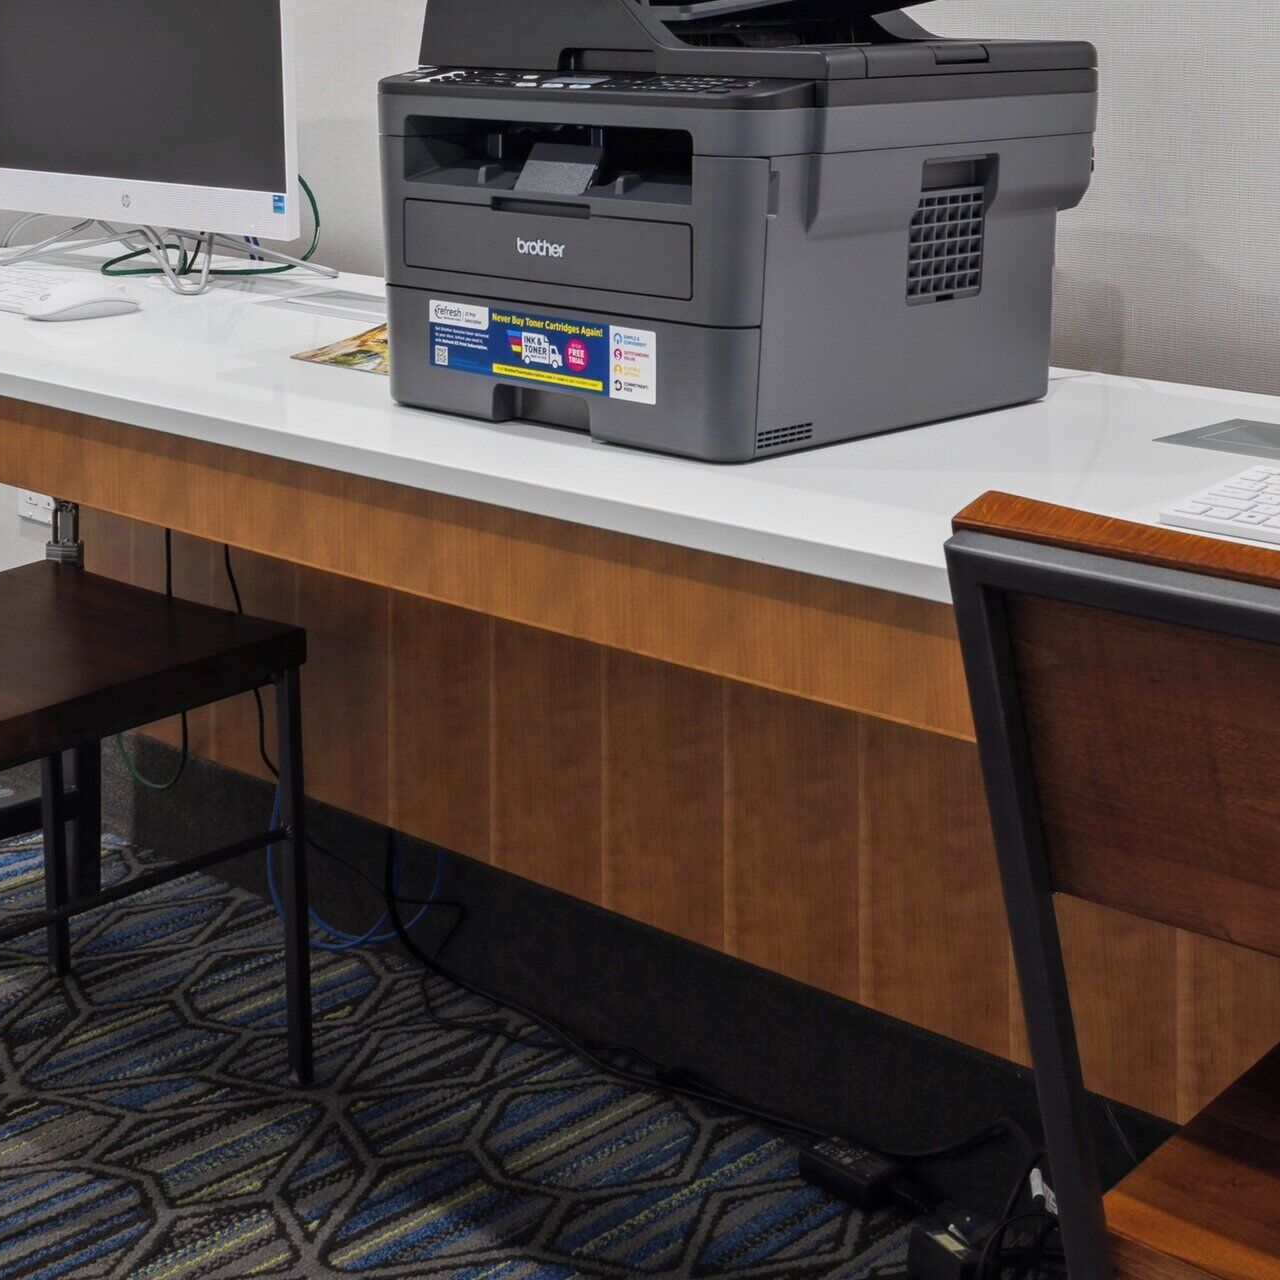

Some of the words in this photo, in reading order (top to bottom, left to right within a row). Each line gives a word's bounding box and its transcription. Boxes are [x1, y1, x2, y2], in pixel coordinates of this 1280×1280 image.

[516, 237, 565, 258] brother
[436, 305, 461, 318] refresh
[492, 313, 511, 322] Never
[511, 316, 524, 326] Buy
[525, 318, 544, 328] Toner
[545, 321, 580, 334] Cartridges
[581, 326, 603, 337] Again!
[524, 336, 536, 344] INK
[537, 338, 542, 346] &
[524, 344, 547, 356] TONER
[568, 348, 585, 358] FREE
[568, 355, 585, 365] TRIAL
